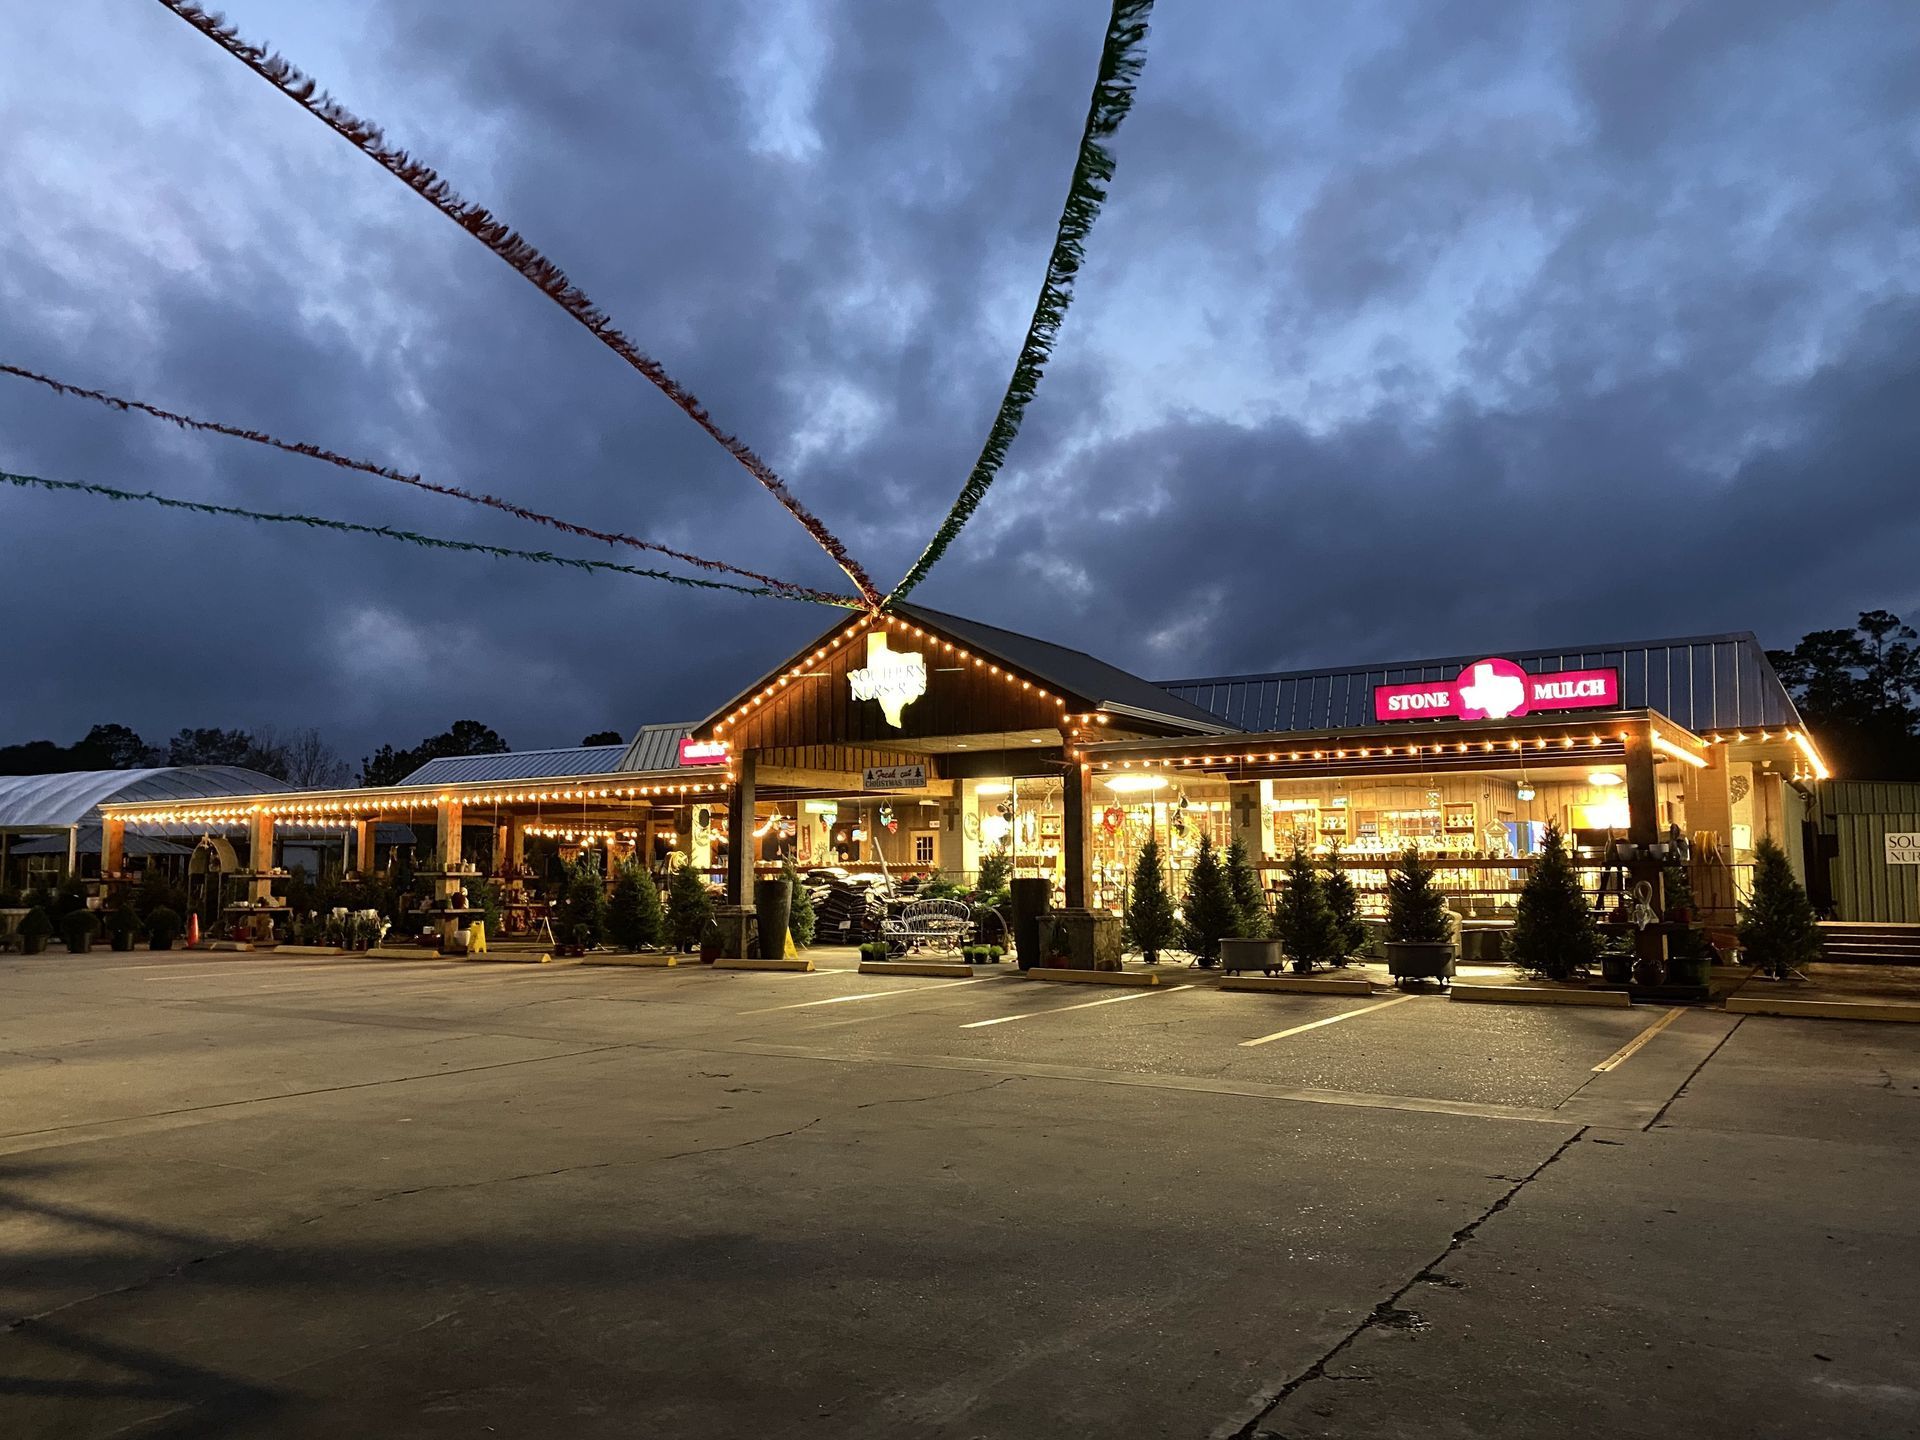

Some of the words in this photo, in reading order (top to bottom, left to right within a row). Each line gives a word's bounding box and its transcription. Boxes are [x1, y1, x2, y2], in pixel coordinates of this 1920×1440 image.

[851, 679, 927, 701] NURSRS
[1388, 691, 1450, 711] STONE
[1534, 679, 1606, 700] MULCH
[875, 769, 896, 779] Fresh
[900, 768, 912, 778] cut
[865, 779, 902, 788] CHRISTMAS
[904, 778, 924, 786] TREES
